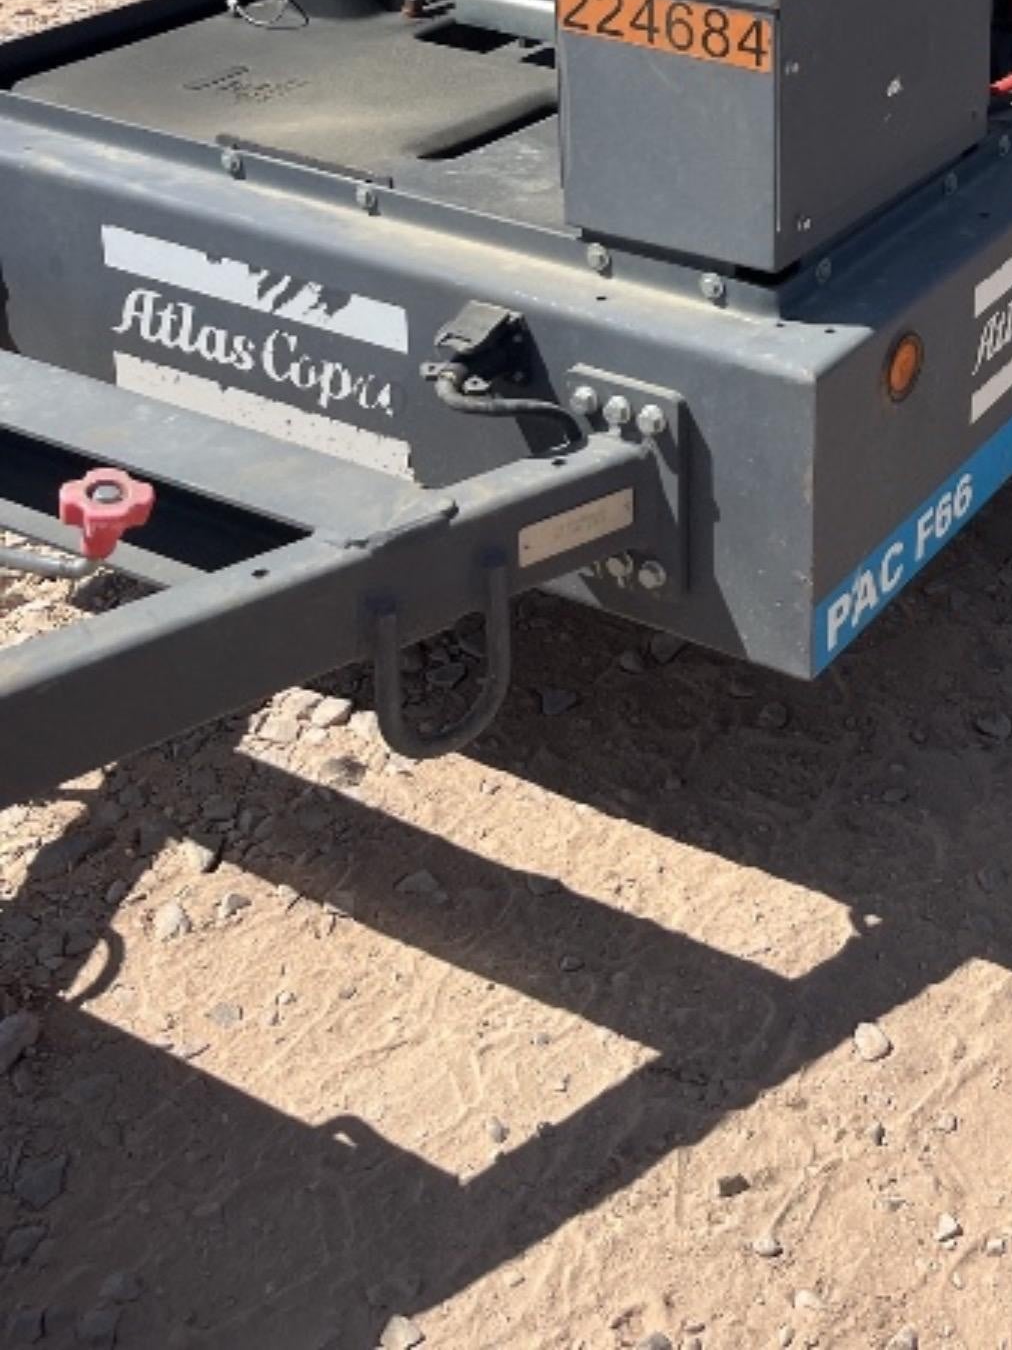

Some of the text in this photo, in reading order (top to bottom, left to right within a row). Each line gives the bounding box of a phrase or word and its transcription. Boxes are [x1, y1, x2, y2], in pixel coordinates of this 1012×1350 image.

[112, 287, 255, 370] Atlas
[826, 474, 974, 651] PAC F66
